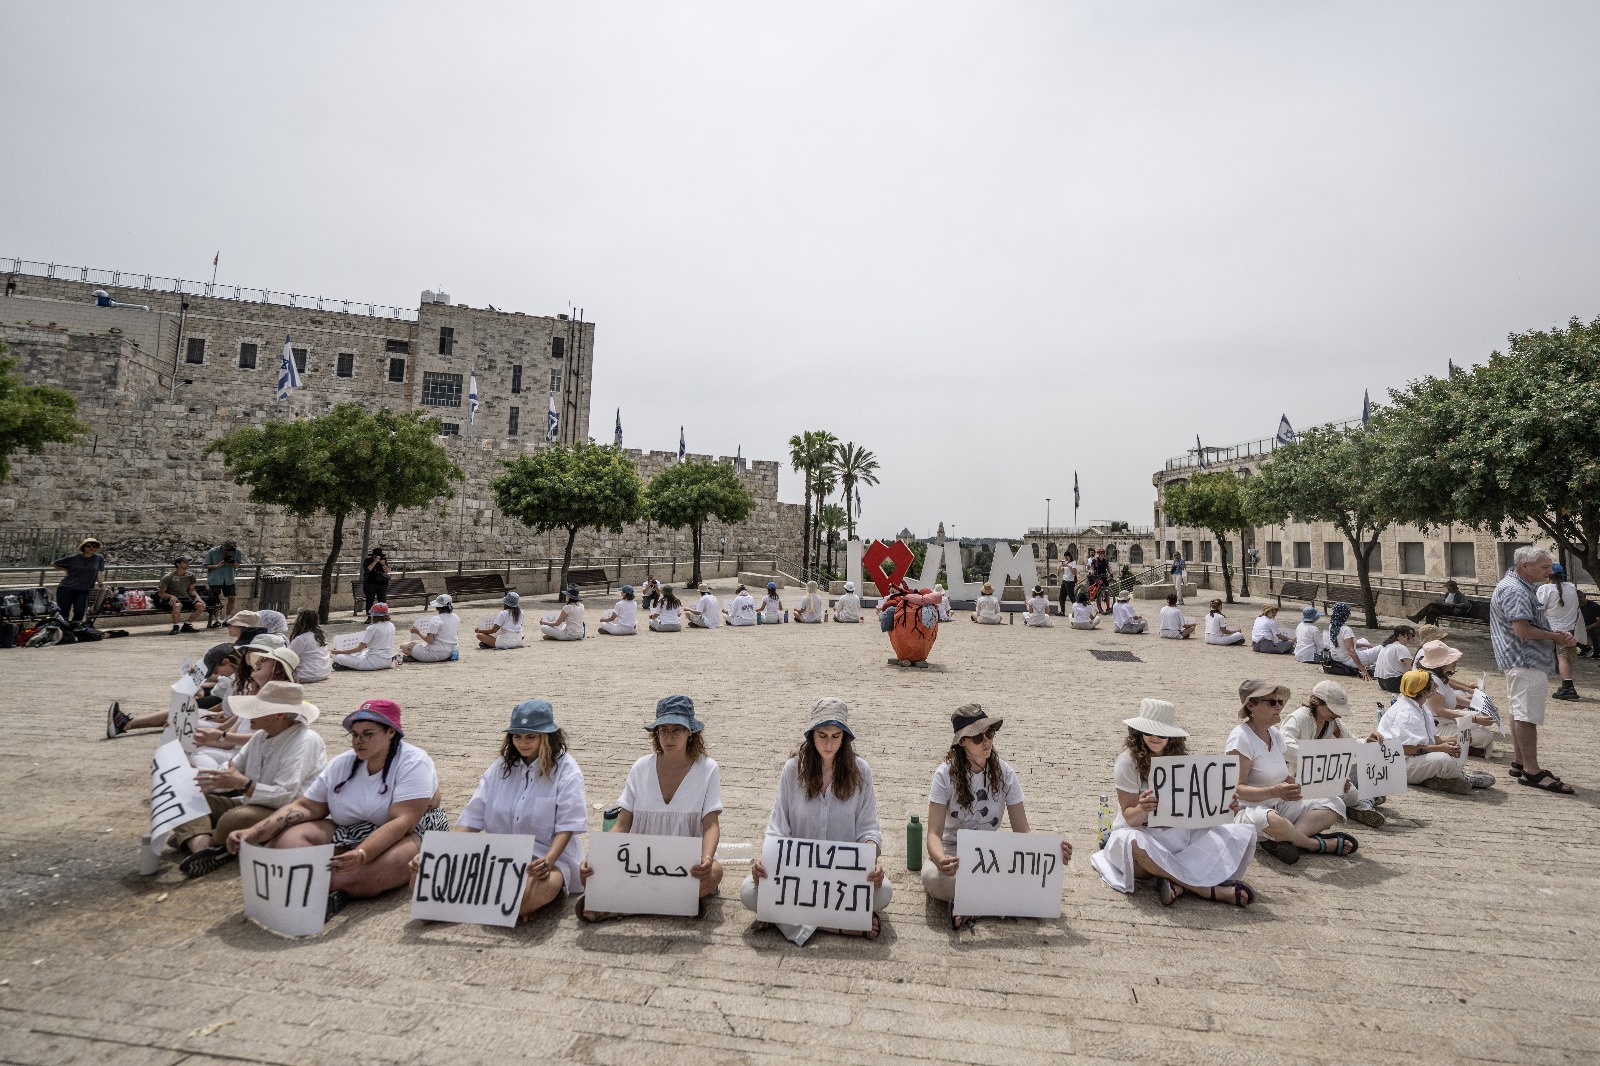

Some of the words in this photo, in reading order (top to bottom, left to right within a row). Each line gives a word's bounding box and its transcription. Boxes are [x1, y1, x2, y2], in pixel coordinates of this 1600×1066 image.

[1153, 762, 1237, 818] PEACE
[617, 843, 688, 878] حماية
[776, 839, 867, 875] בטחון
[971, 847, 1000, 874] גג
[1007, 851, 1056, 888] קורת
[253, 860, 314, 907] חיים
[773, 875, 871, 912] תזונתי
